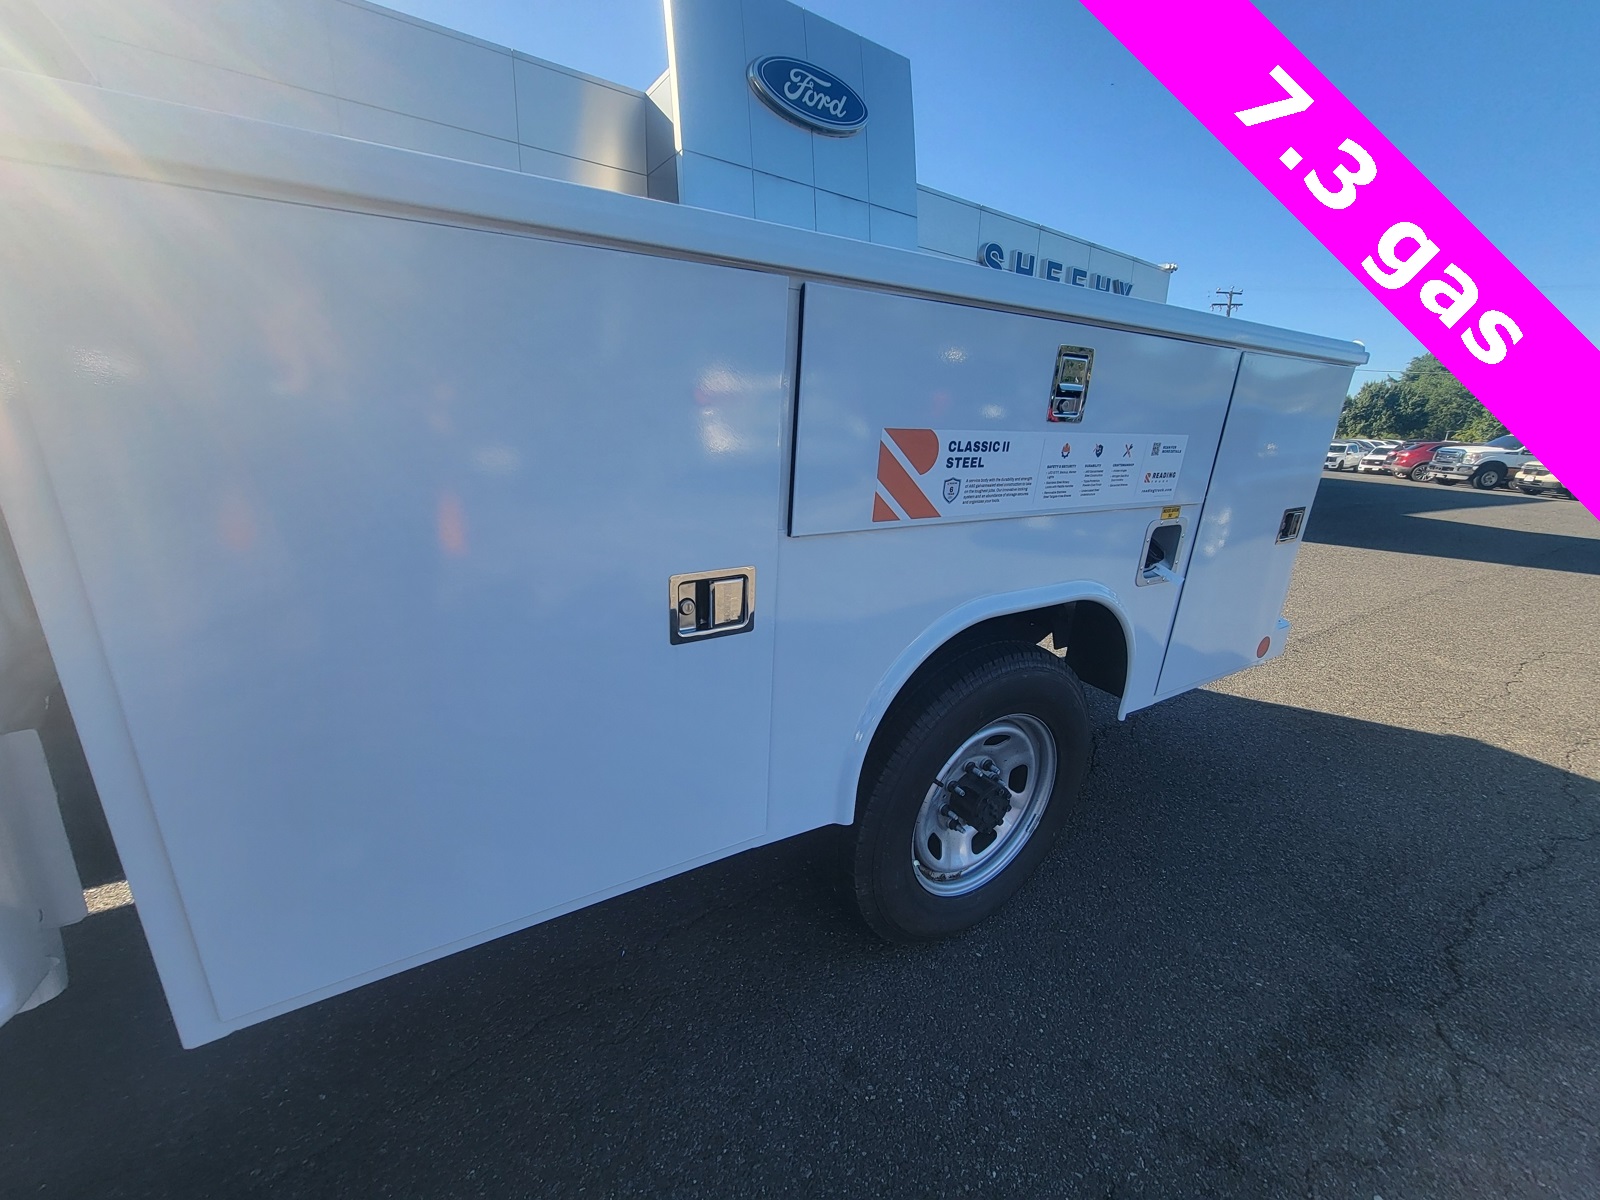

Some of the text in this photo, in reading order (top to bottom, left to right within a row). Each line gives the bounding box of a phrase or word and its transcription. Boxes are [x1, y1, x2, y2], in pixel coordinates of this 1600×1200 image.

[784, 68, 847, 118] Ford
[948, 440, 1010, 453] CLASSIC II
[945, 457, 985, 469] STEEL
